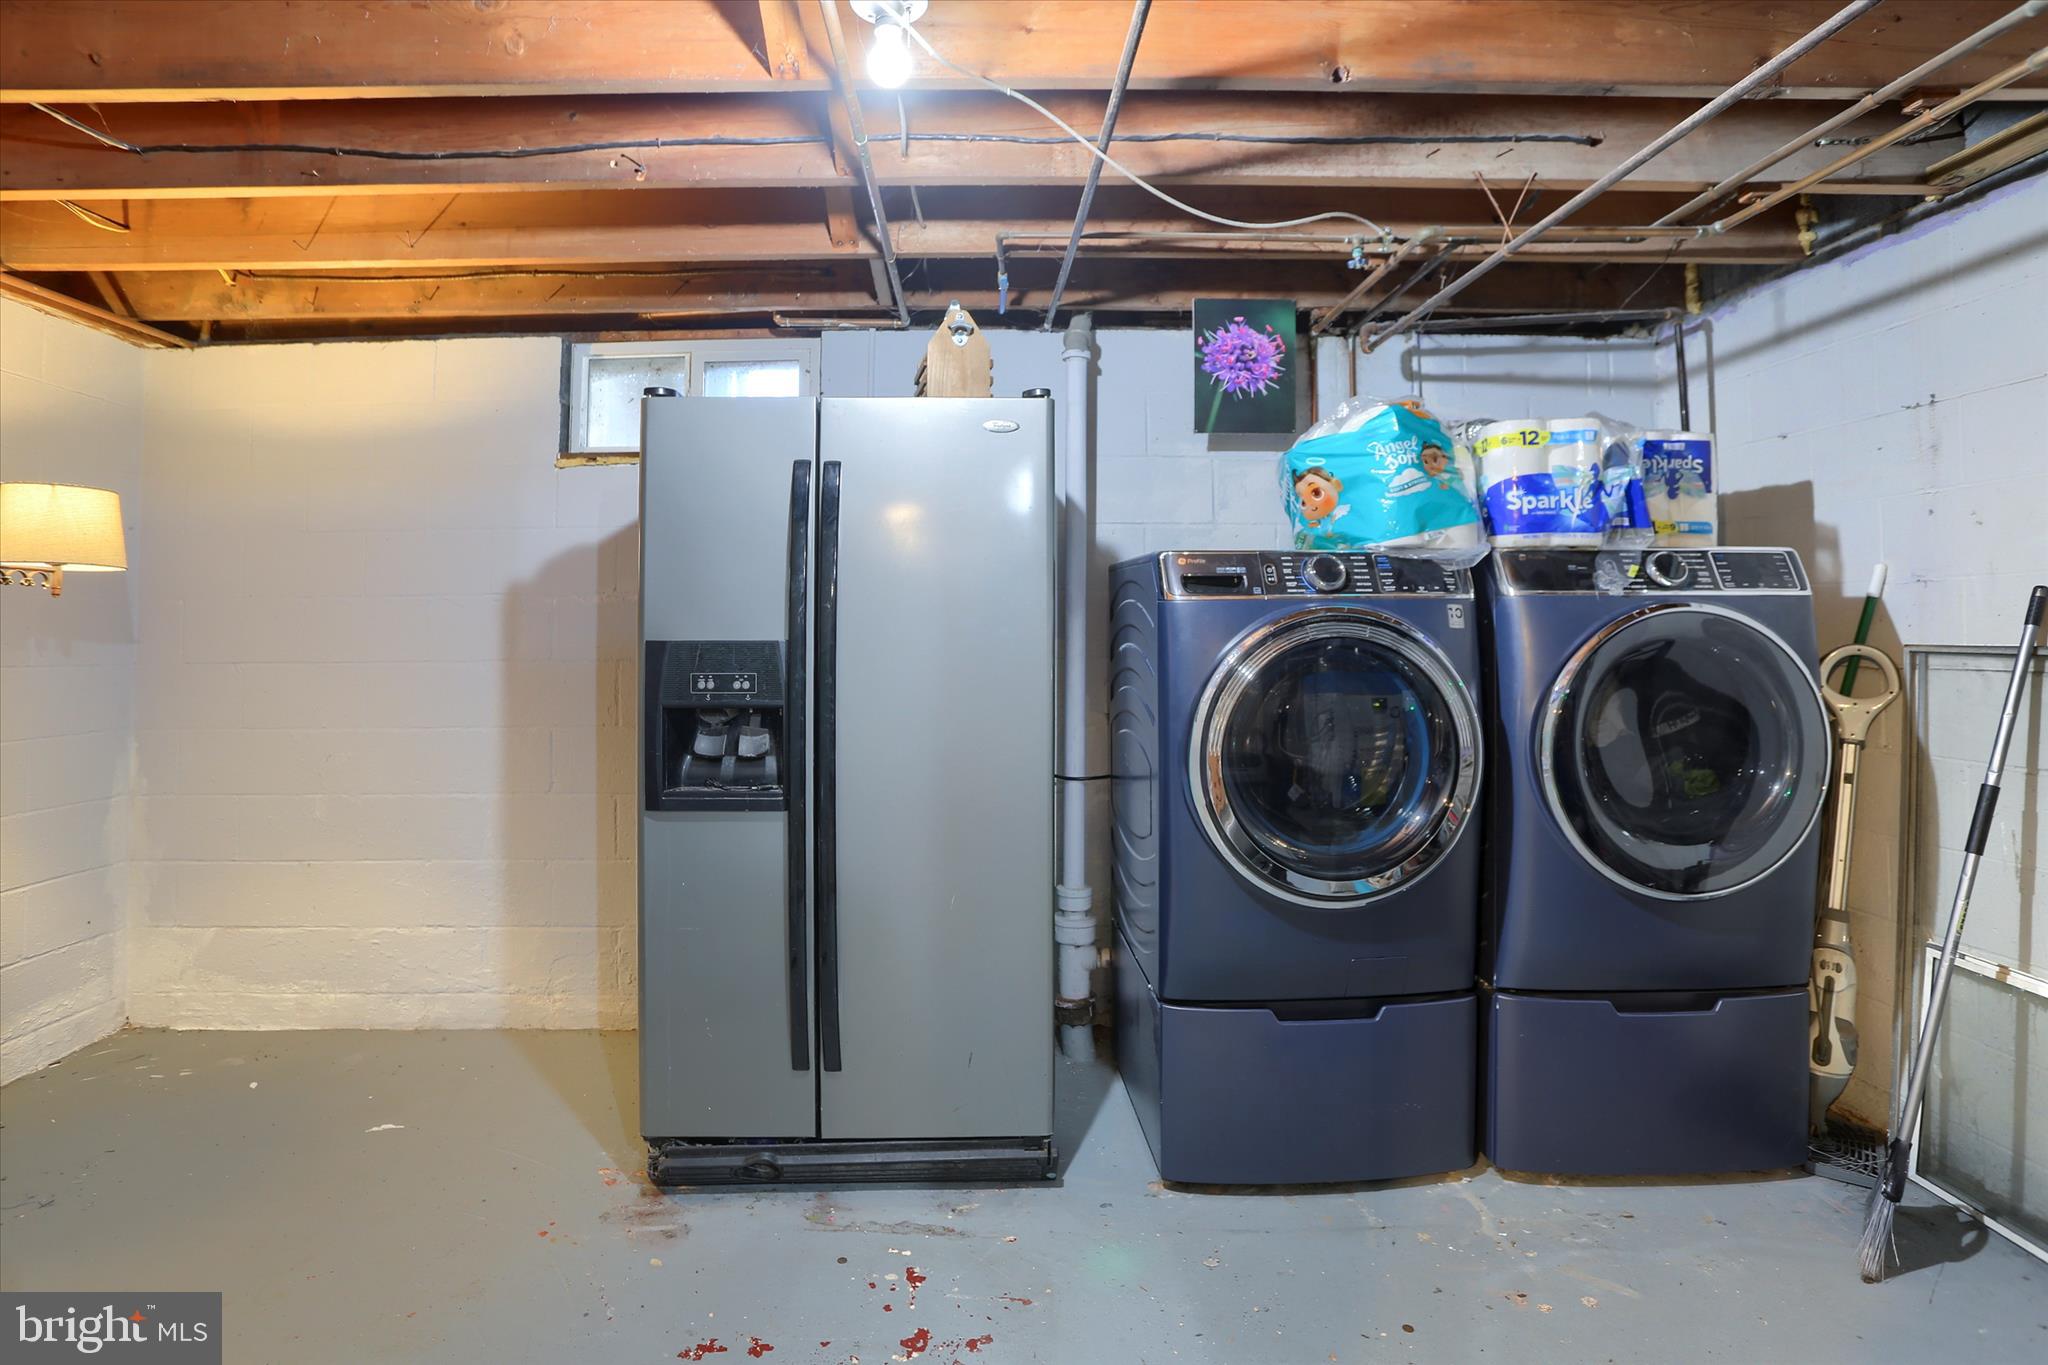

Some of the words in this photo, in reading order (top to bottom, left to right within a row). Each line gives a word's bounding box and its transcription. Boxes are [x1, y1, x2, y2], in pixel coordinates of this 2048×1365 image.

[1366, 435, 1419, 461] Angel
[1520, 431, 1540, 445] 12
[1384, 450, 1419, 470] Soft
[1505, 486, 1595, 515] Sparkle
